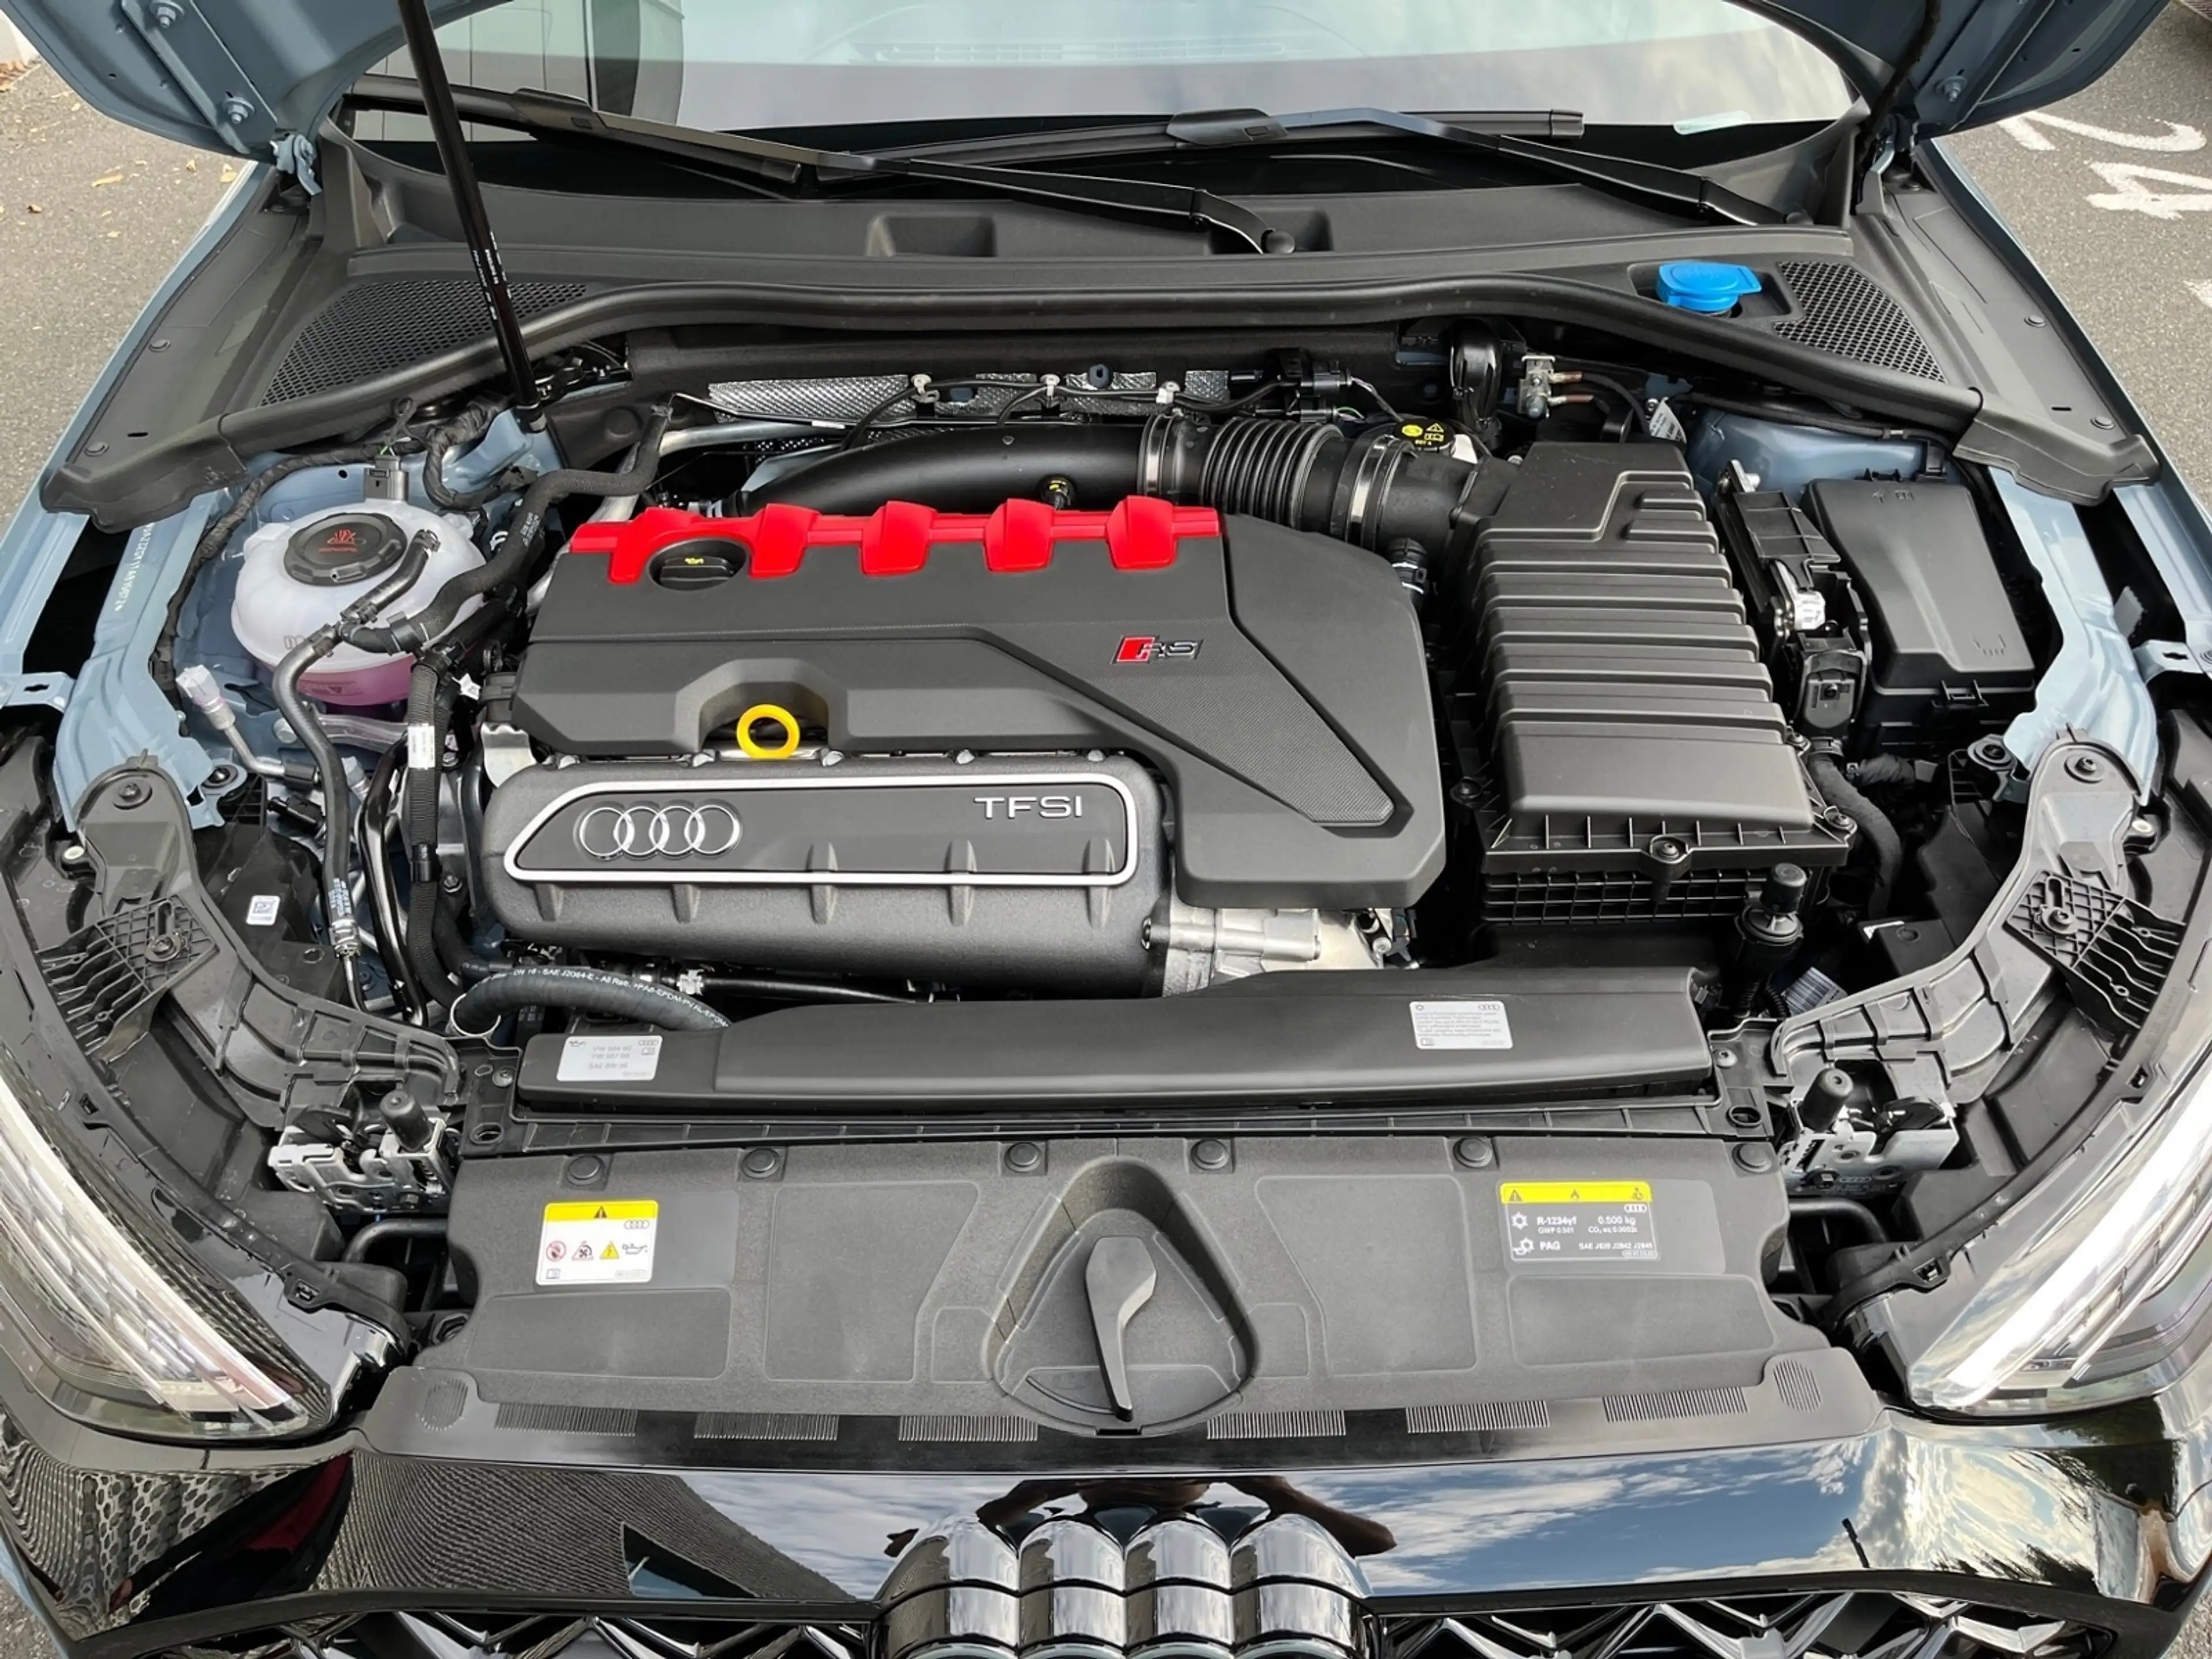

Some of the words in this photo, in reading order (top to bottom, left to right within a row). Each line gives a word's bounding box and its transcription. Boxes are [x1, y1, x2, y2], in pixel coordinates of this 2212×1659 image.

[1130, 639, 1199, 660] RS
[974, 796, 1082, 819] TFSI
[1537, 1216, 1577, 1226] R-1234yf
[1624, 1215, 1636, 1226] kg
[1540, 1241, 1560, 1251] PAG
